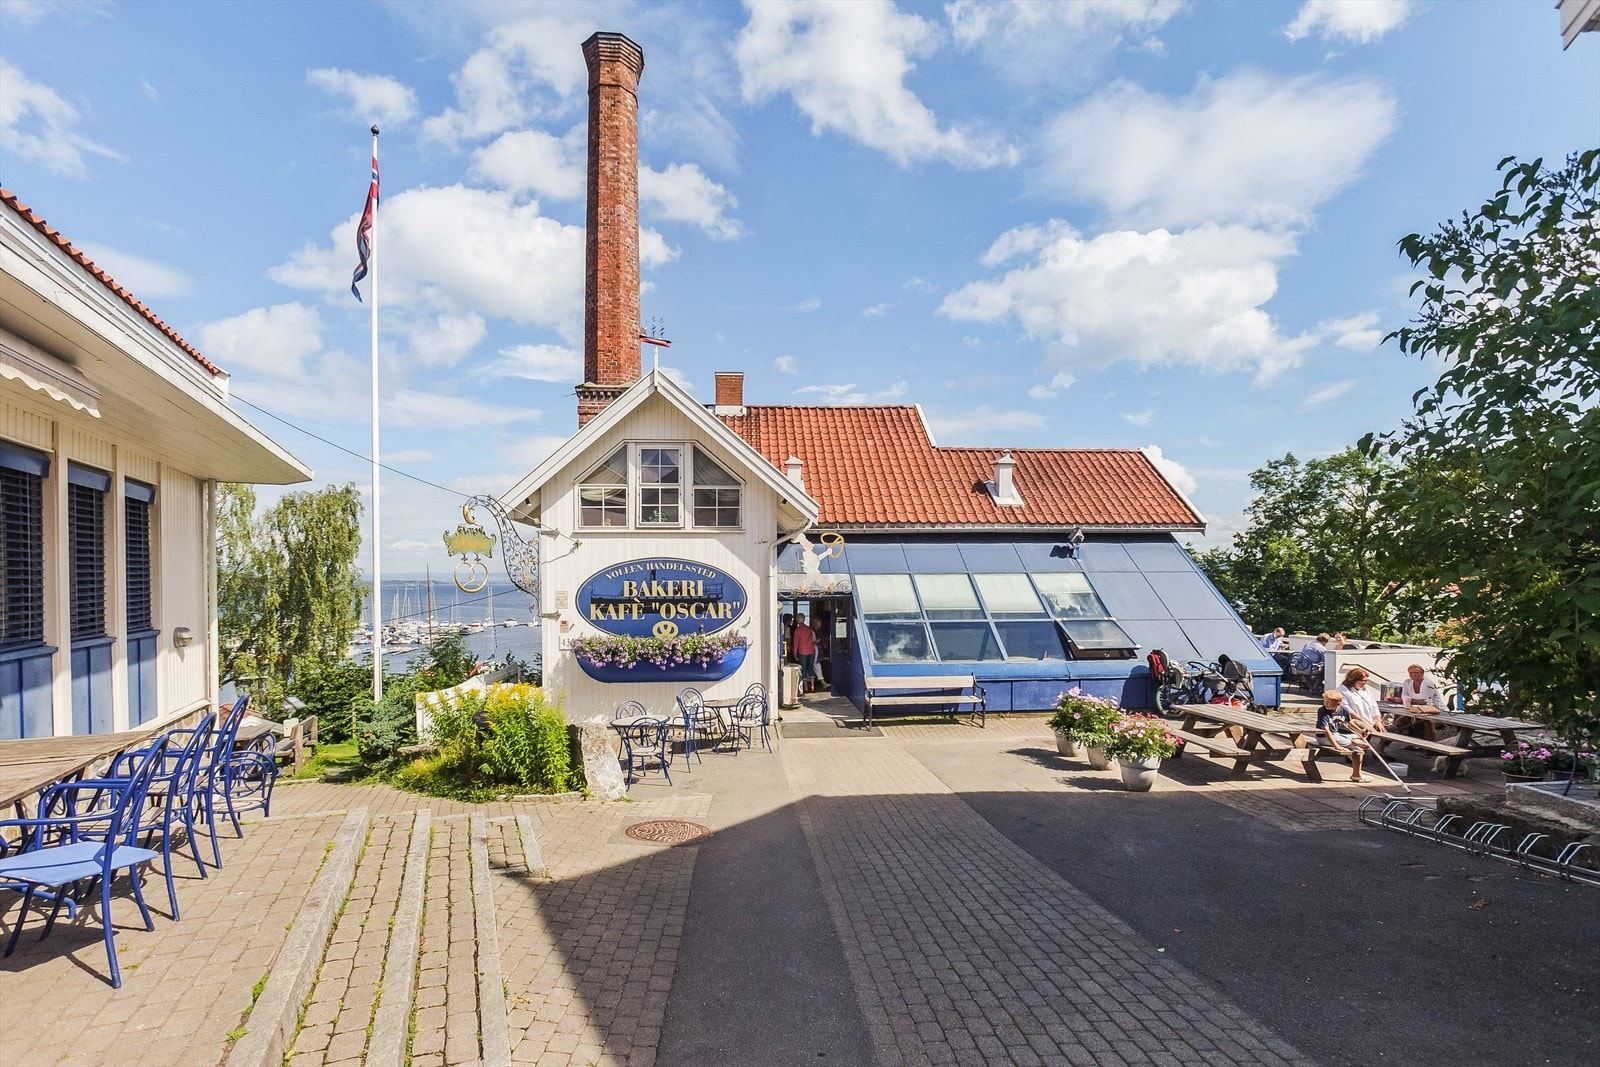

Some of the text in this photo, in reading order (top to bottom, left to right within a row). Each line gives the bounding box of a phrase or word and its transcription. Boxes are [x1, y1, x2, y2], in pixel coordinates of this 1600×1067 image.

[606, 562, 716, 580] VOLLEN HANDELSSTED
[623, 580, 704, 597] BAKERI
[652, 602, 740, 620] "OSCAR"
